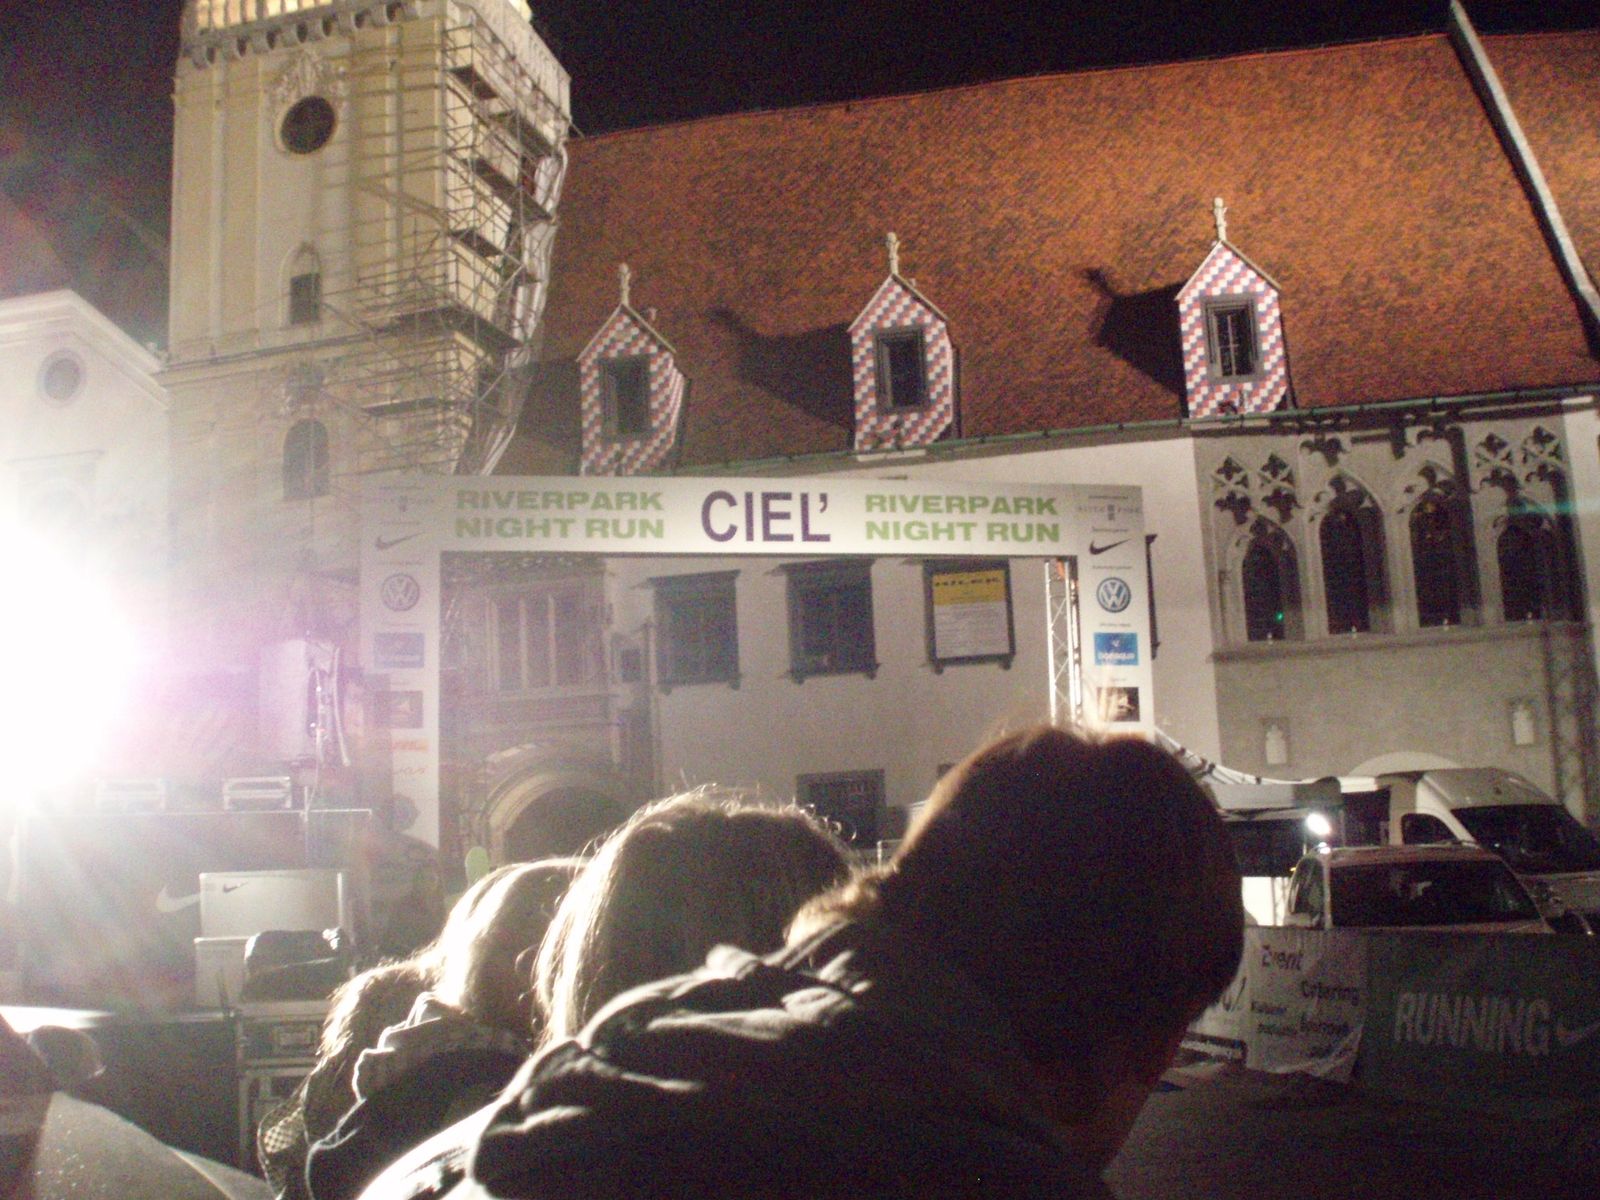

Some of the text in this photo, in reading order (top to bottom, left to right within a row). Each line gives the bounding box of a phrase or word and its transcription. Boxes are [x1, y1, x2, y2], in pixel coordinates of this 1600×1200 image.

[456, 490, 664, 511] RIVERPARK
[865, 494, 1058, 515] RIVERPARK
[454, 517, 664, 539] NIGHT RUN
[865, 520, 1060, 542] NIGHT RUN
[1394, 991, 1551, 1056] RUNNING
